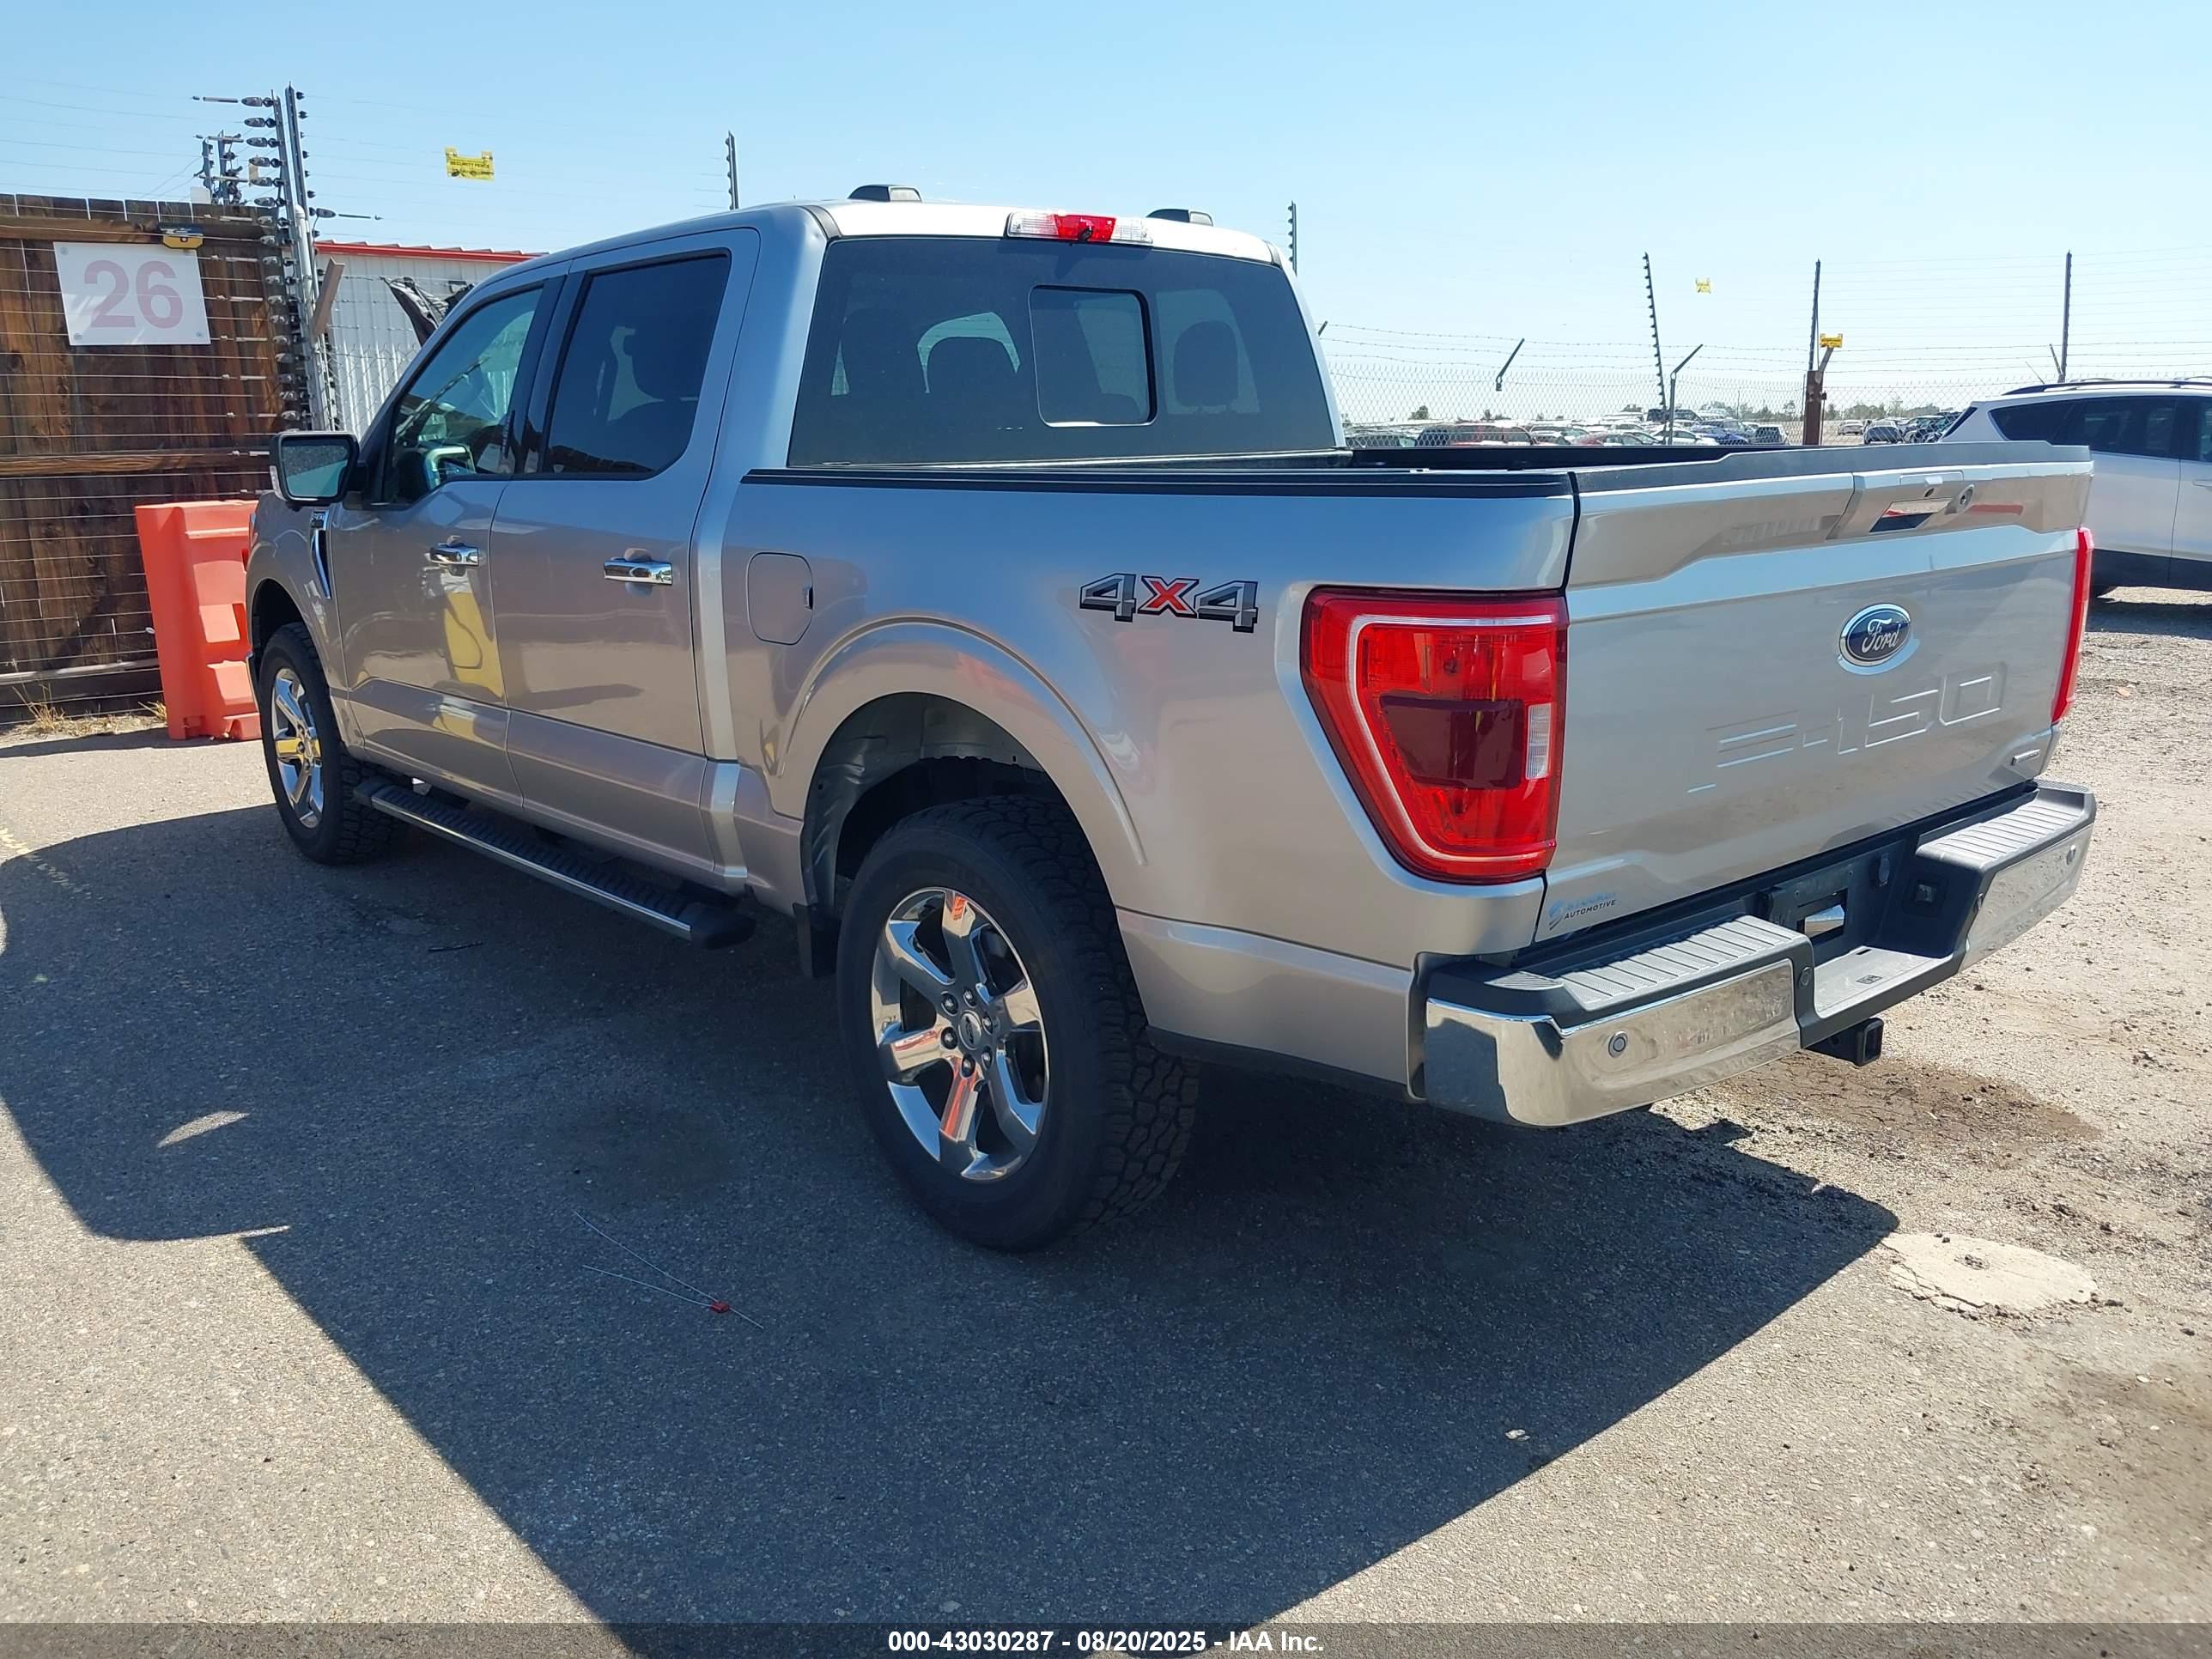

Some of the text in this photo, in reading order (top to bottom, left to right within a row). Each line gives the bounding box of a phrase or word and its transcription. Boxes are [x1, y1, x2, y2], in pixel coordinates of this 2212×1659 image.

[84, 260, 183, 329] 26
[1862, 618, 1899, 653] Ford
[1564, 899, 1616, 919] AUTOMOTIVE
